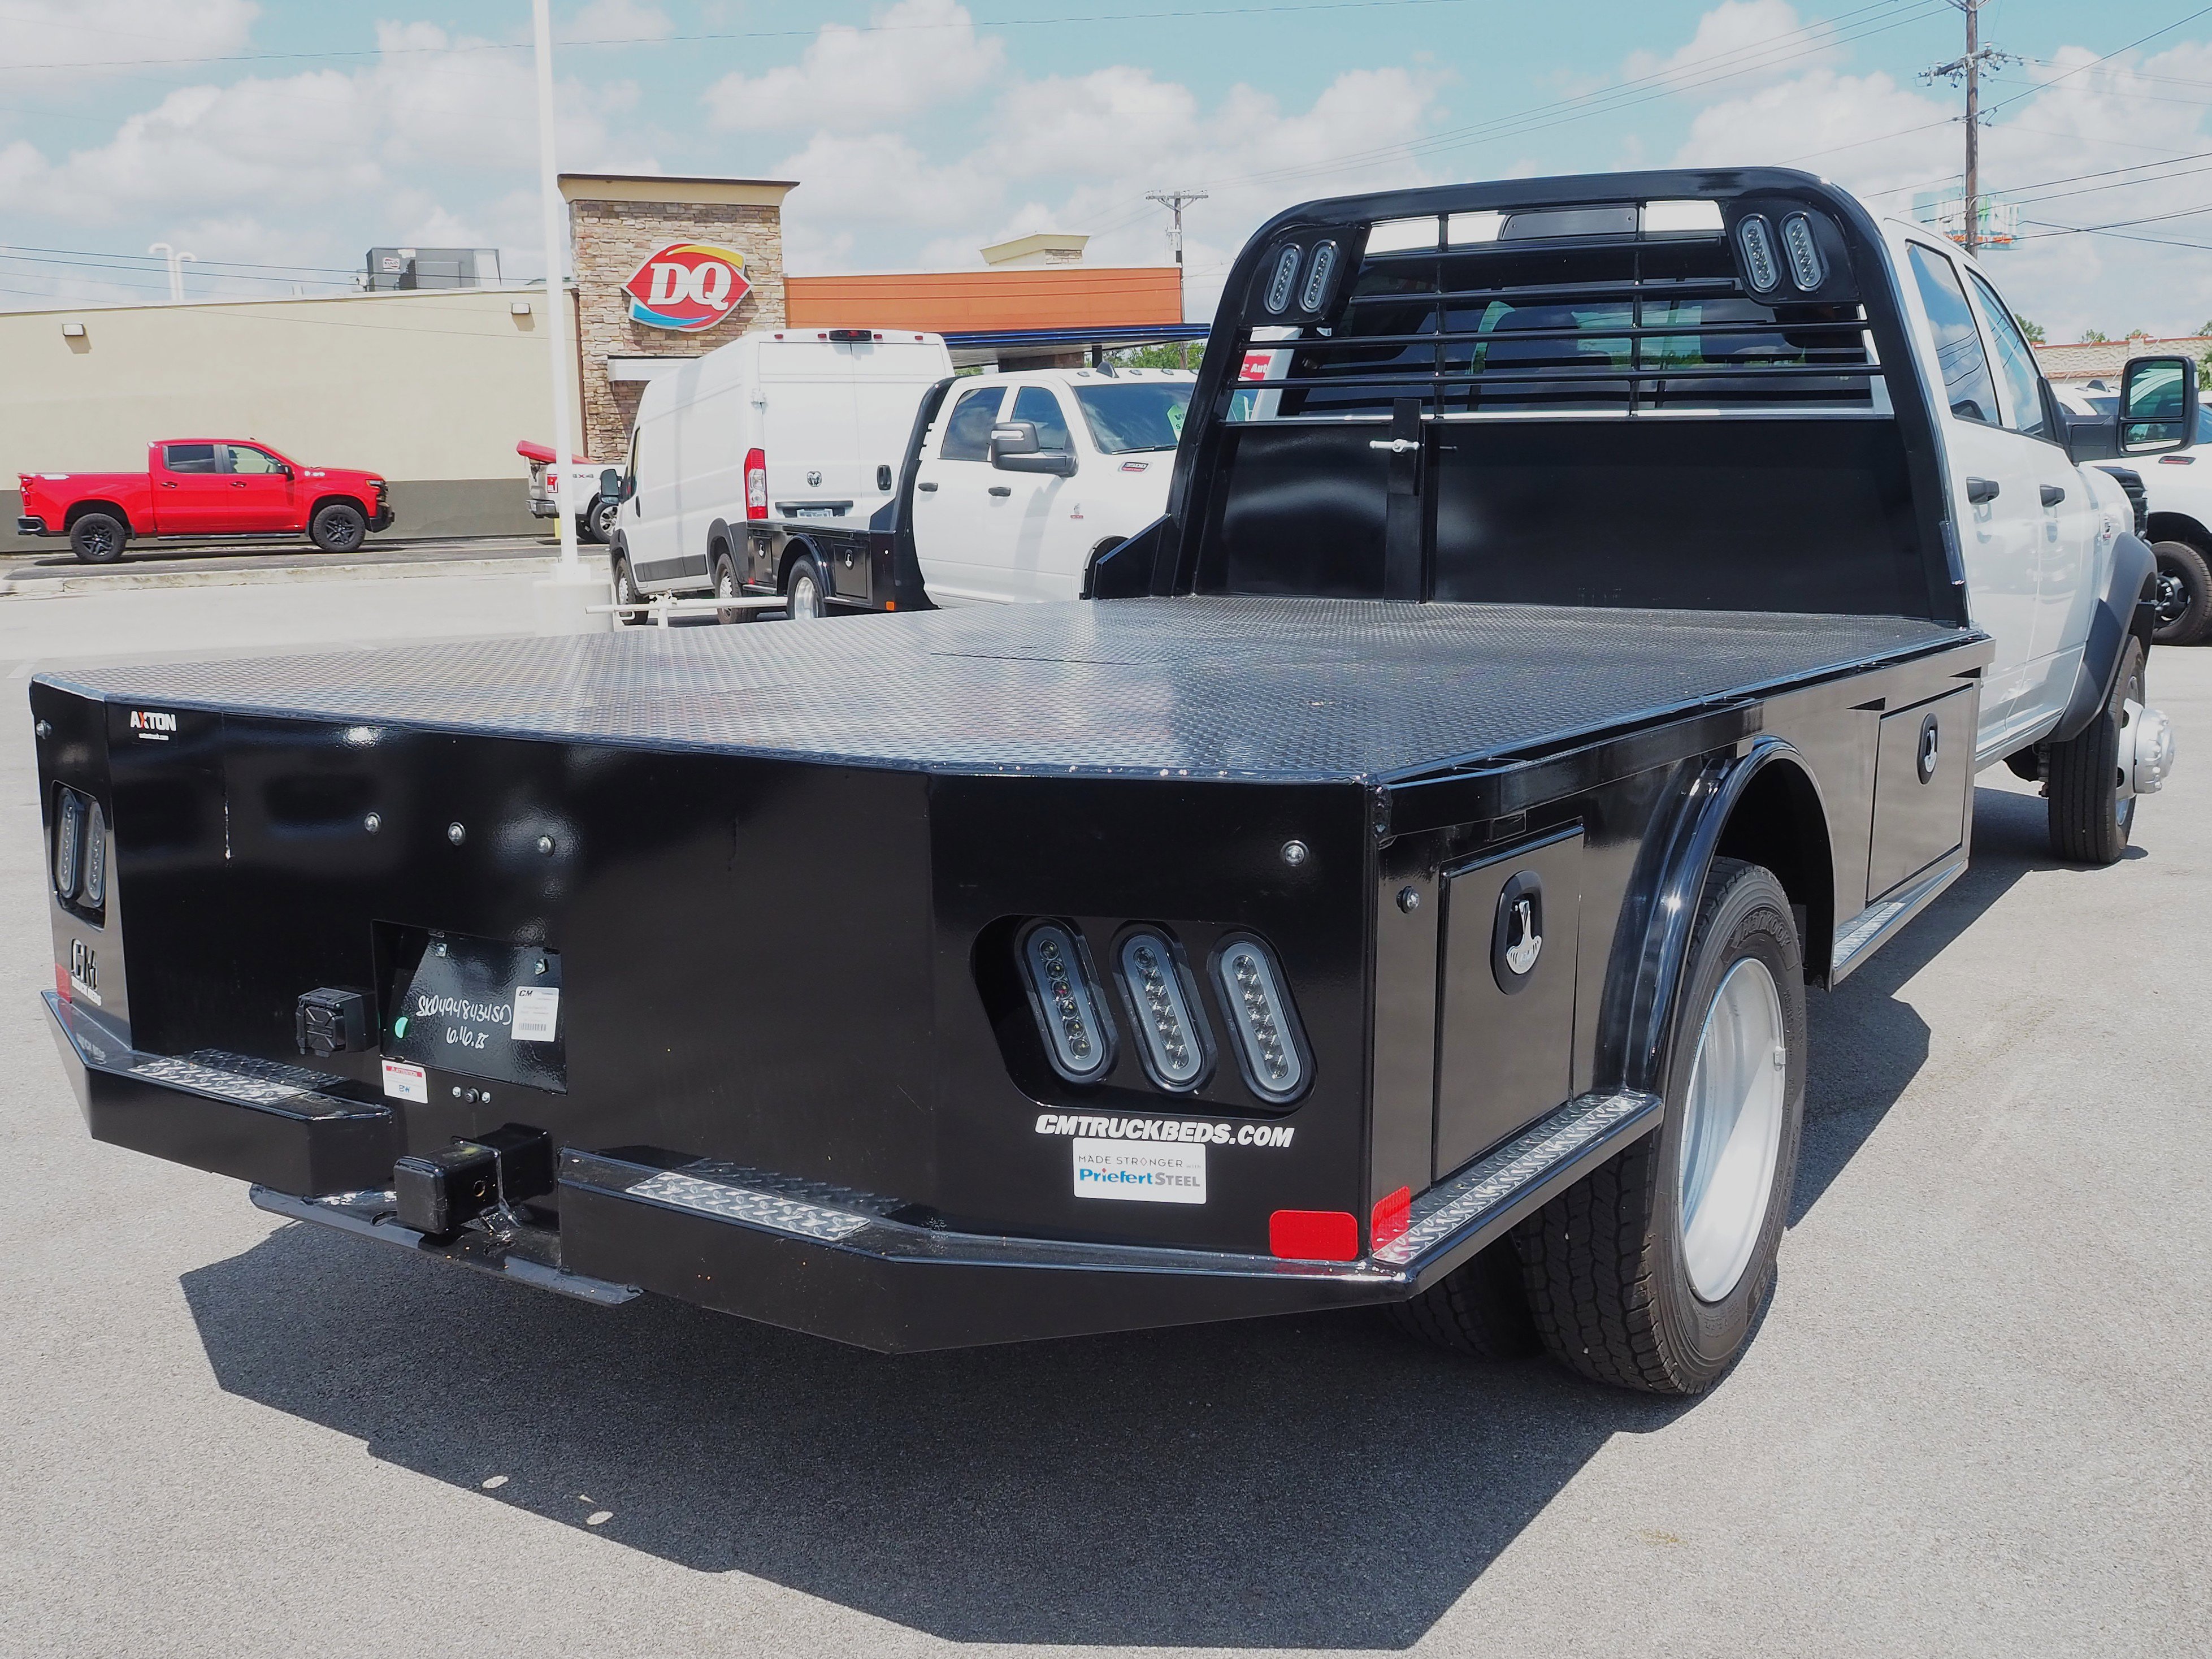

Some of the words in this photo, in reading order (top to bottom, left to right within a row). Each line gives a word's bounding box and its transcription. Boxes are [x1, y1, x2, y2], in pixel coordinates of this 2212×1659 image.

[648, 262, 731, 311] DQ
[130, 711, 176, 731] AXTON
[1035, 1114, 1295, 1147] CMTRUCKBEDS.COM
[1078, 1155, 1112, 1164] MADE
[1116, 1157, 1183, 1167] STRONGER
